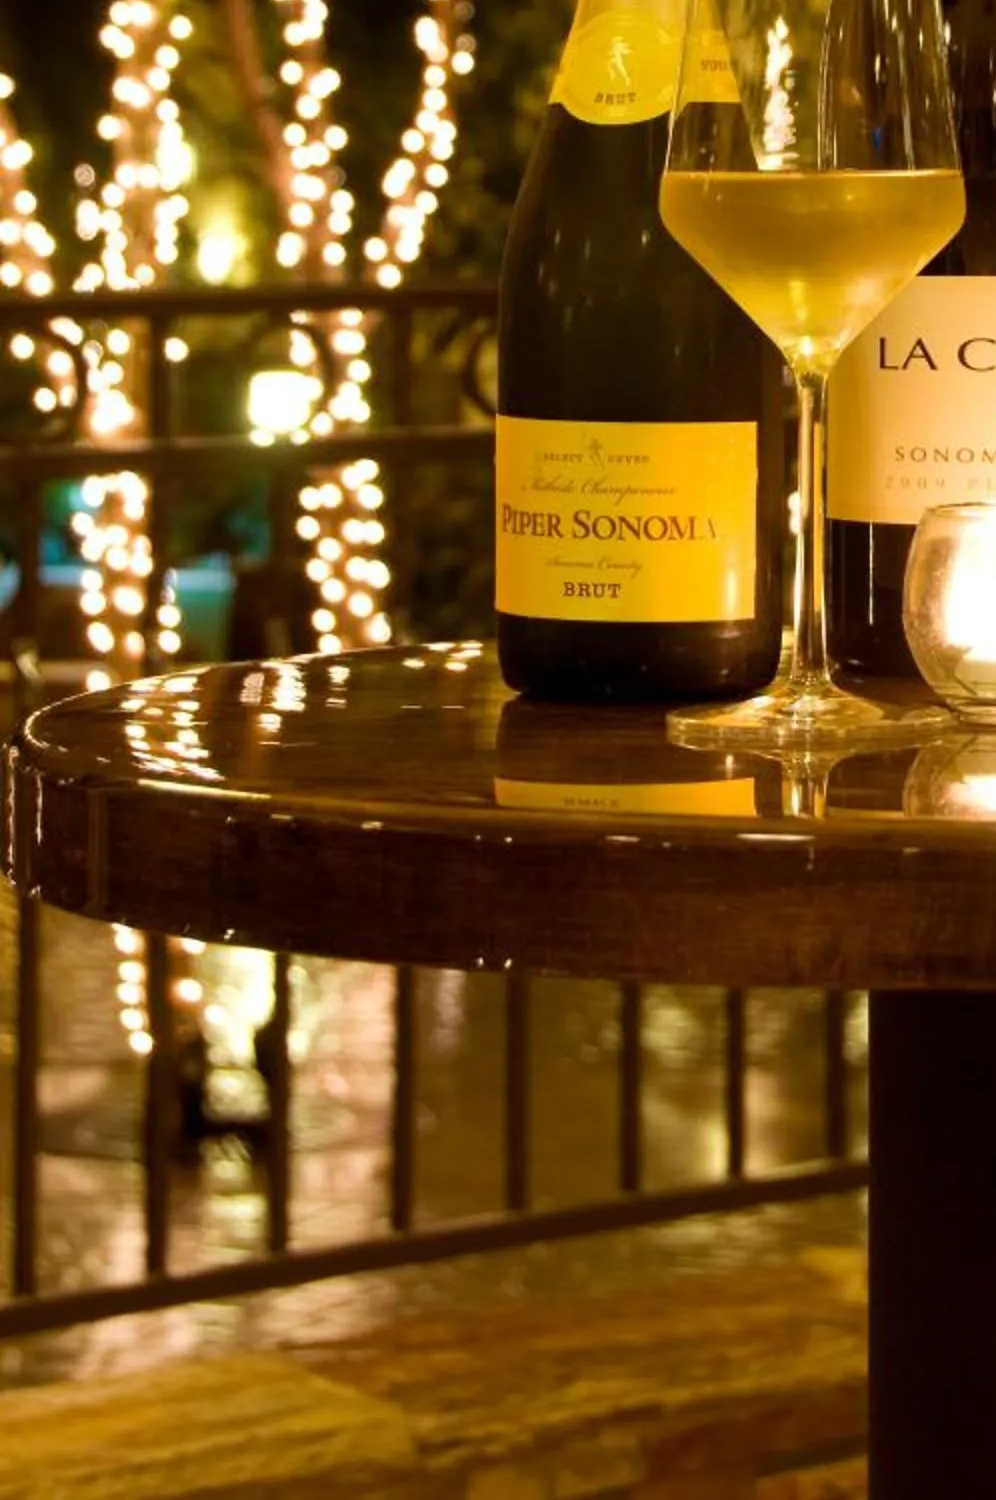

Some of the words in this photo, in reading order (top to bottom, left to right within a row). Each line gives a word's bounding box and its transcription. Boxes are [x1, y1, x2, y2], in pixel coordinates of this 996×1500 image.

[878, 337, 938, 371] LA
[502, 503, 564, 538] PIPER
[562, 581, 622, 599] BRUT
